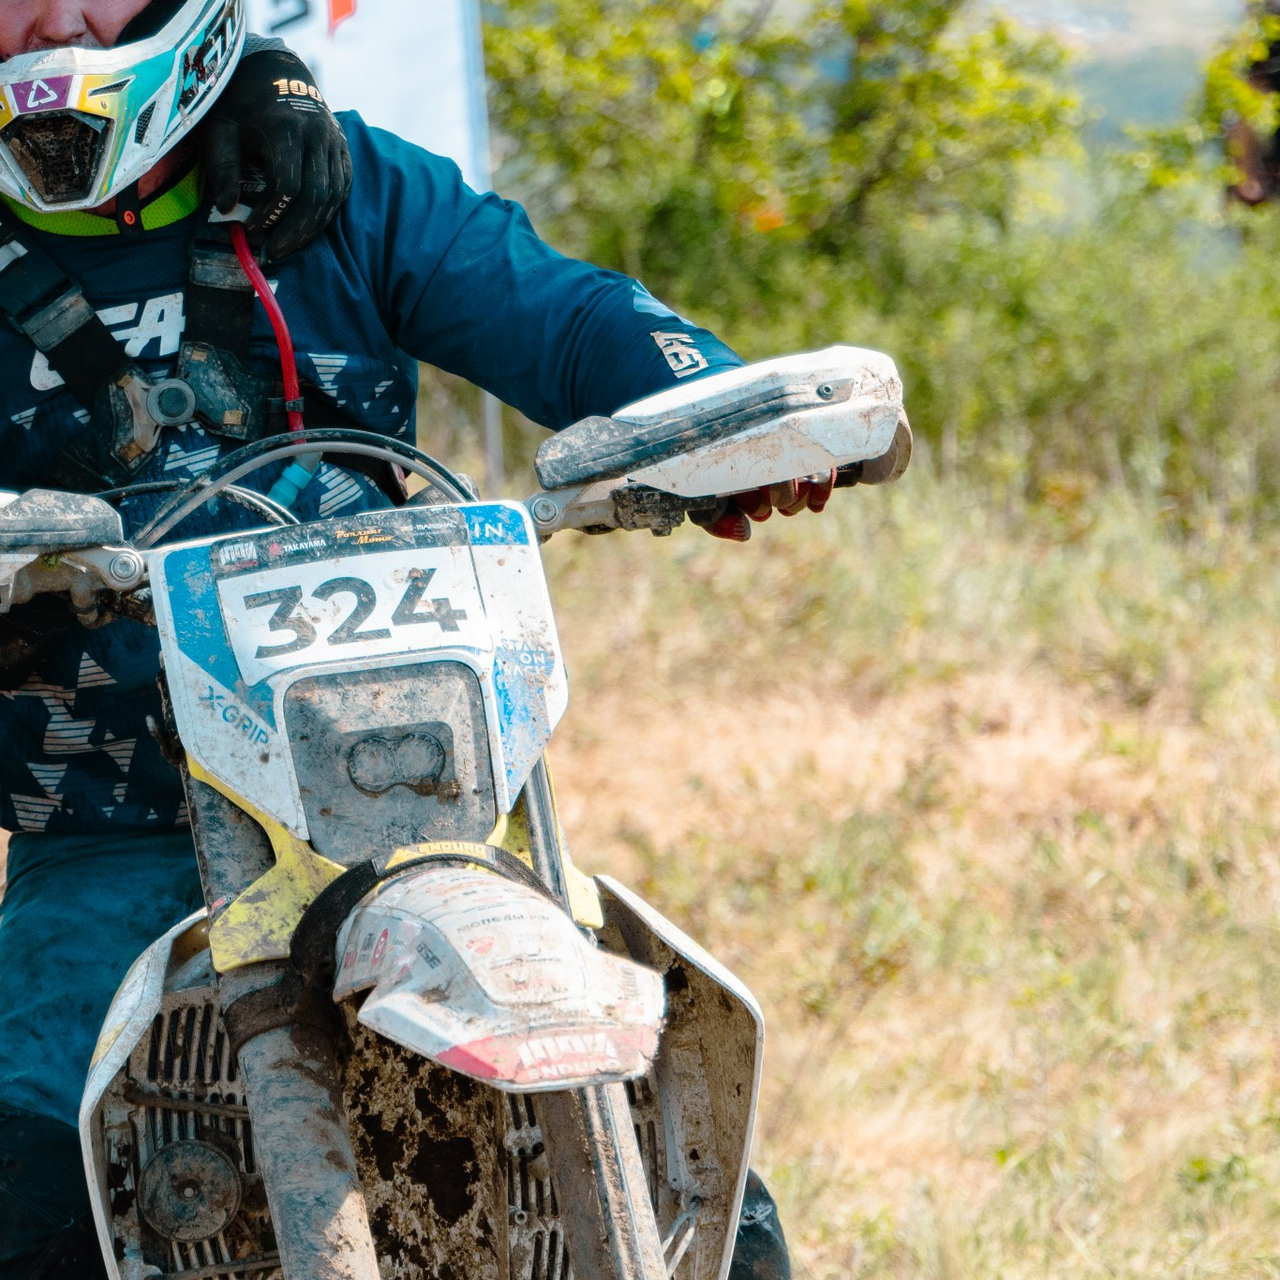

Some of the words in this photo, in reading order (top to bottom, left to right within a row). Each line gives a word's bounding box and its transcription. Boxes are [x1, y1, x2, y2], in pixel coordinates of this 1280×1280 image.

[283, 539, 327, 553] TAKAYAMA
[243, 568, 469, 659] 324
[520, 652, 545, 664] ON
[198, 685, 269, 745] X-GRIP
[417, 841, 486, 855] ENDURO
[525, 1058, 621, 1078] ENDURO
